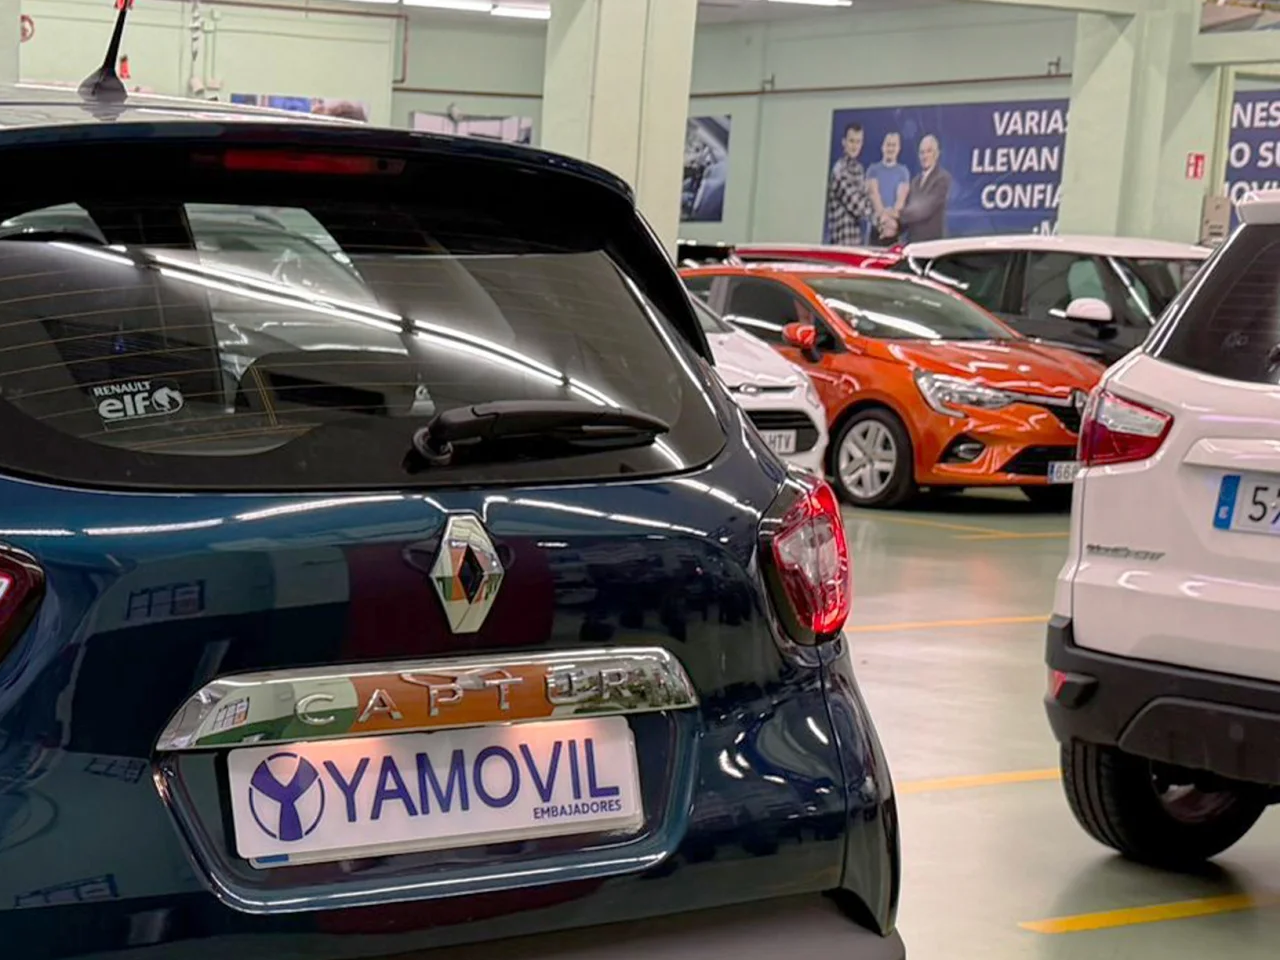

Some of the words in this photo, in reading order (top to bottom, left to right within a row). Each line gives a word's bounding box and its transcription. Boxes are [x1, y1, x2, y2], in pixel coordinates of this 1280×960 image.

[993, 109, 1069, 136] VARIA
[971, 145, 1060, 173] LLEVAN
[93, 381, 152, 397] RENAULT
[98, 392, 150, 419] elf
[322, 738, 620, 822] YAMOVIL
[532, 799, 622, 820] EMBAJADORES
